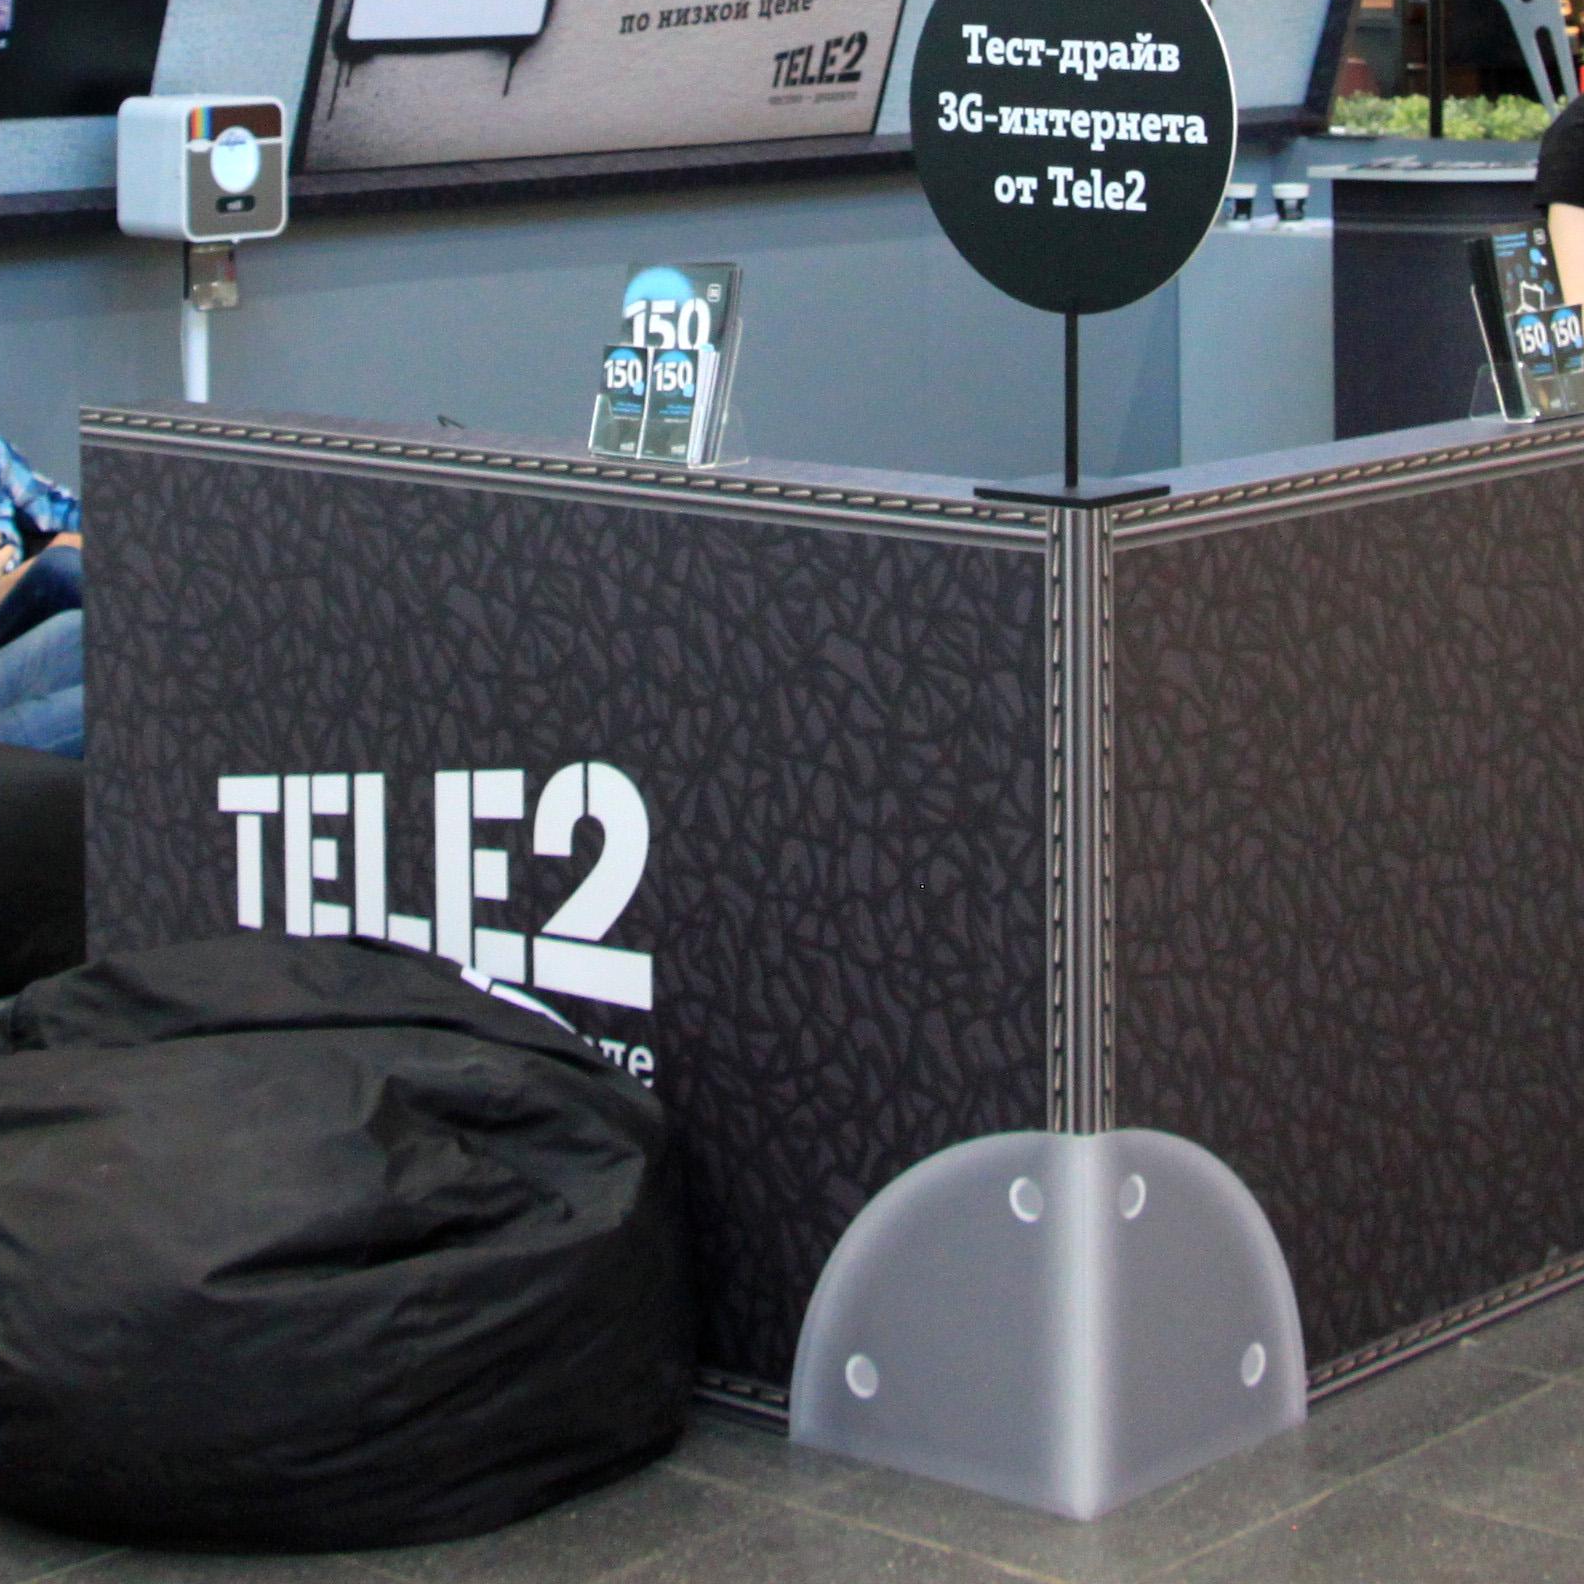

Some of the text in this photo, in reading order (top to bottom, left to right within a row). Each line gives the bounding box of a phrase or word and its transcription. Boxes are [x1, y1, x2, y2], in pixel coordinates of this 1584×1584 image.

[619, 12, 651, 35] по
[771, 30, 869, 89] TELE2
[961, 23, 1181, 81] Тест-драйв
[937, 90, 1209, 152] 3G-интернета
[993, 165, 1148, 212] от Tele2
[623, 297, 712, 351] 150
[1516, 321, 1548, 355] 150
[1550, 315, 1581, 348] 150
[603, 359, 644, 389] 150
[652, 360, 694, 392] 150
[217, 761, 654, 1011] TELE2
